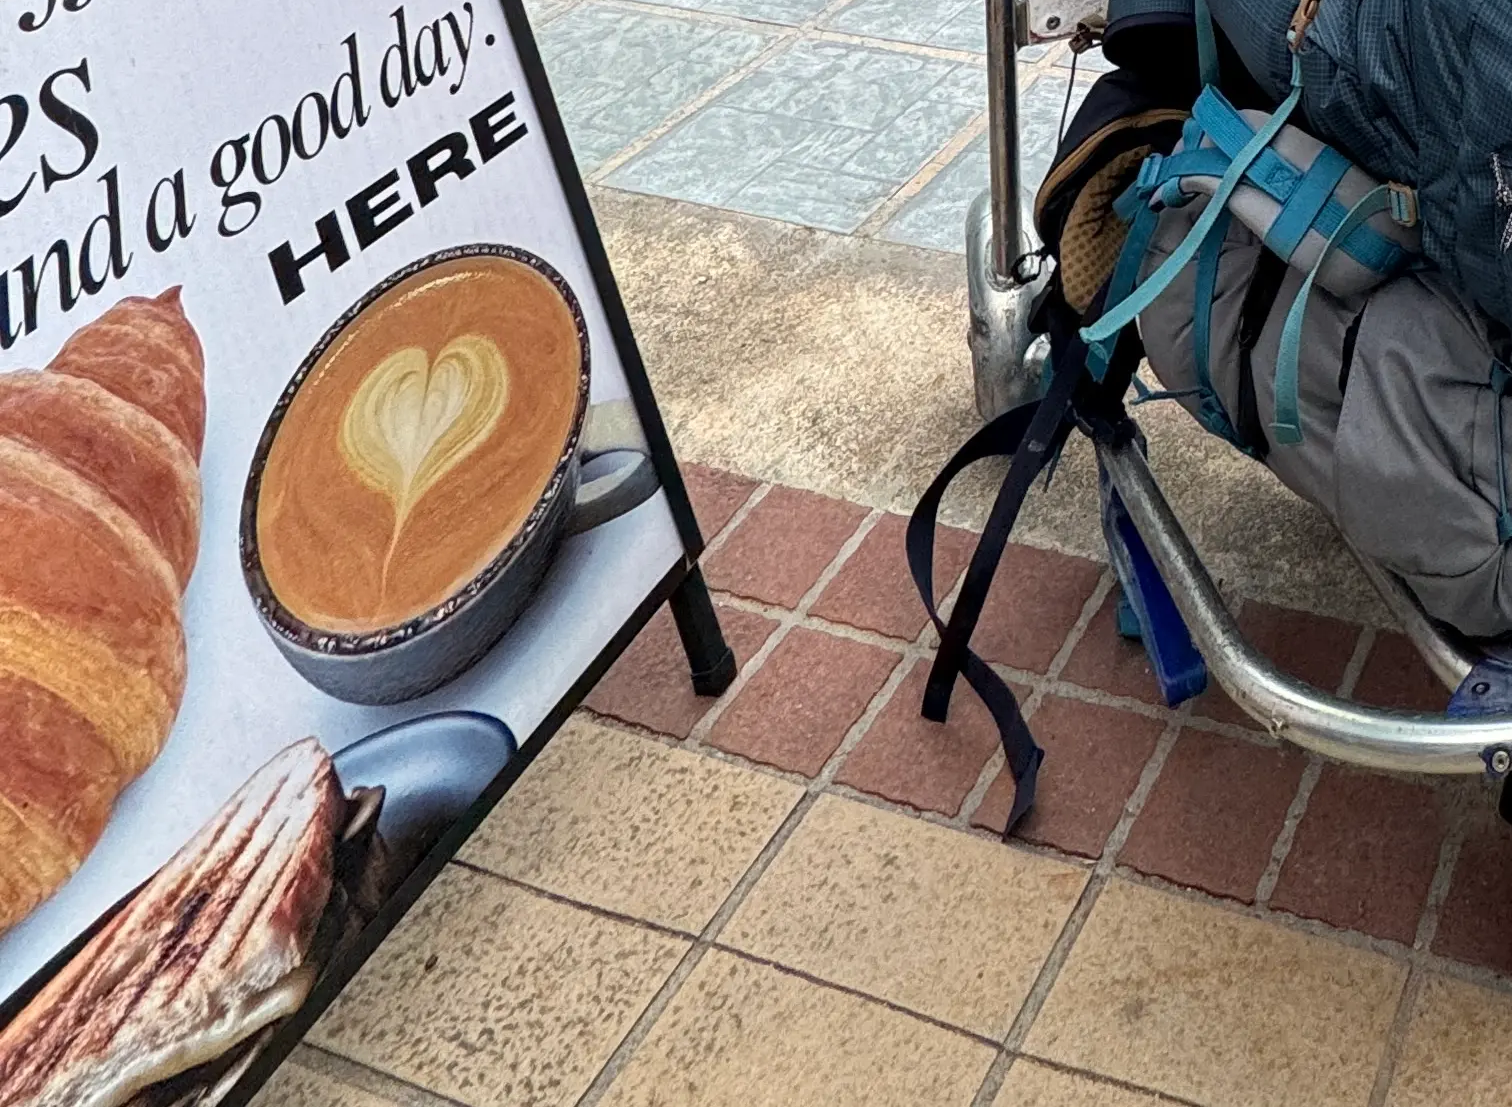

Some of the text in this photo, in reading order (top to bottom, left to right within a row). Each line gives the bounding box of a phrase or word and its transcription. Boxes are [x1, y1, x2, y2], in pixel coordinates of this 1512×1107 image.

[146, 168, 197, 253] a
[210, 32, 371, 238] good
[380, 1, 495, 108] day.
[267, 90, 529, 306] HERE
